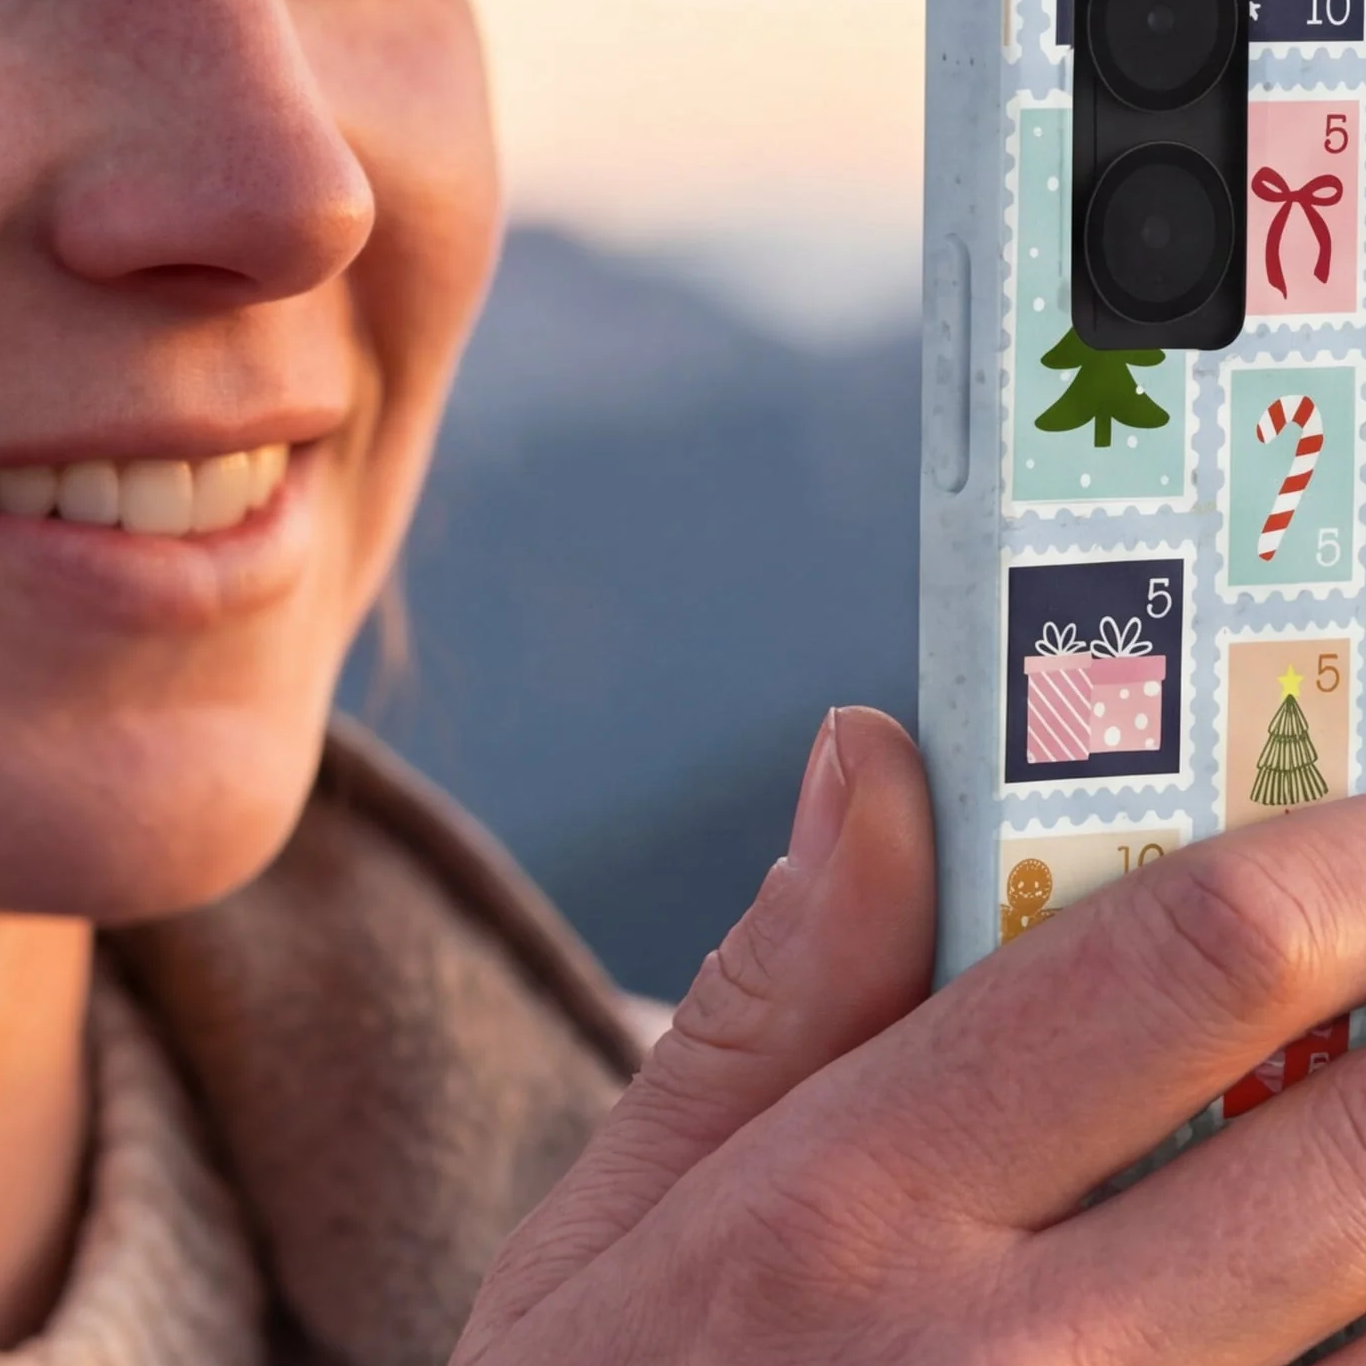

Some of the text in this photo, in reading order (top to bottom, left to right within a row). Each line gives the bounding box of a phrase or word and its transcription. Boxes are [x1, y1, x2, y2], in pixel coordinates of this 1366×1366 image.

[1323, 114, 1349, 155] 5
[1315, 527, 1341, 567] 5
[1146, 577, 1173, 619] 5
[1315, 653, 1341, 693] 5
